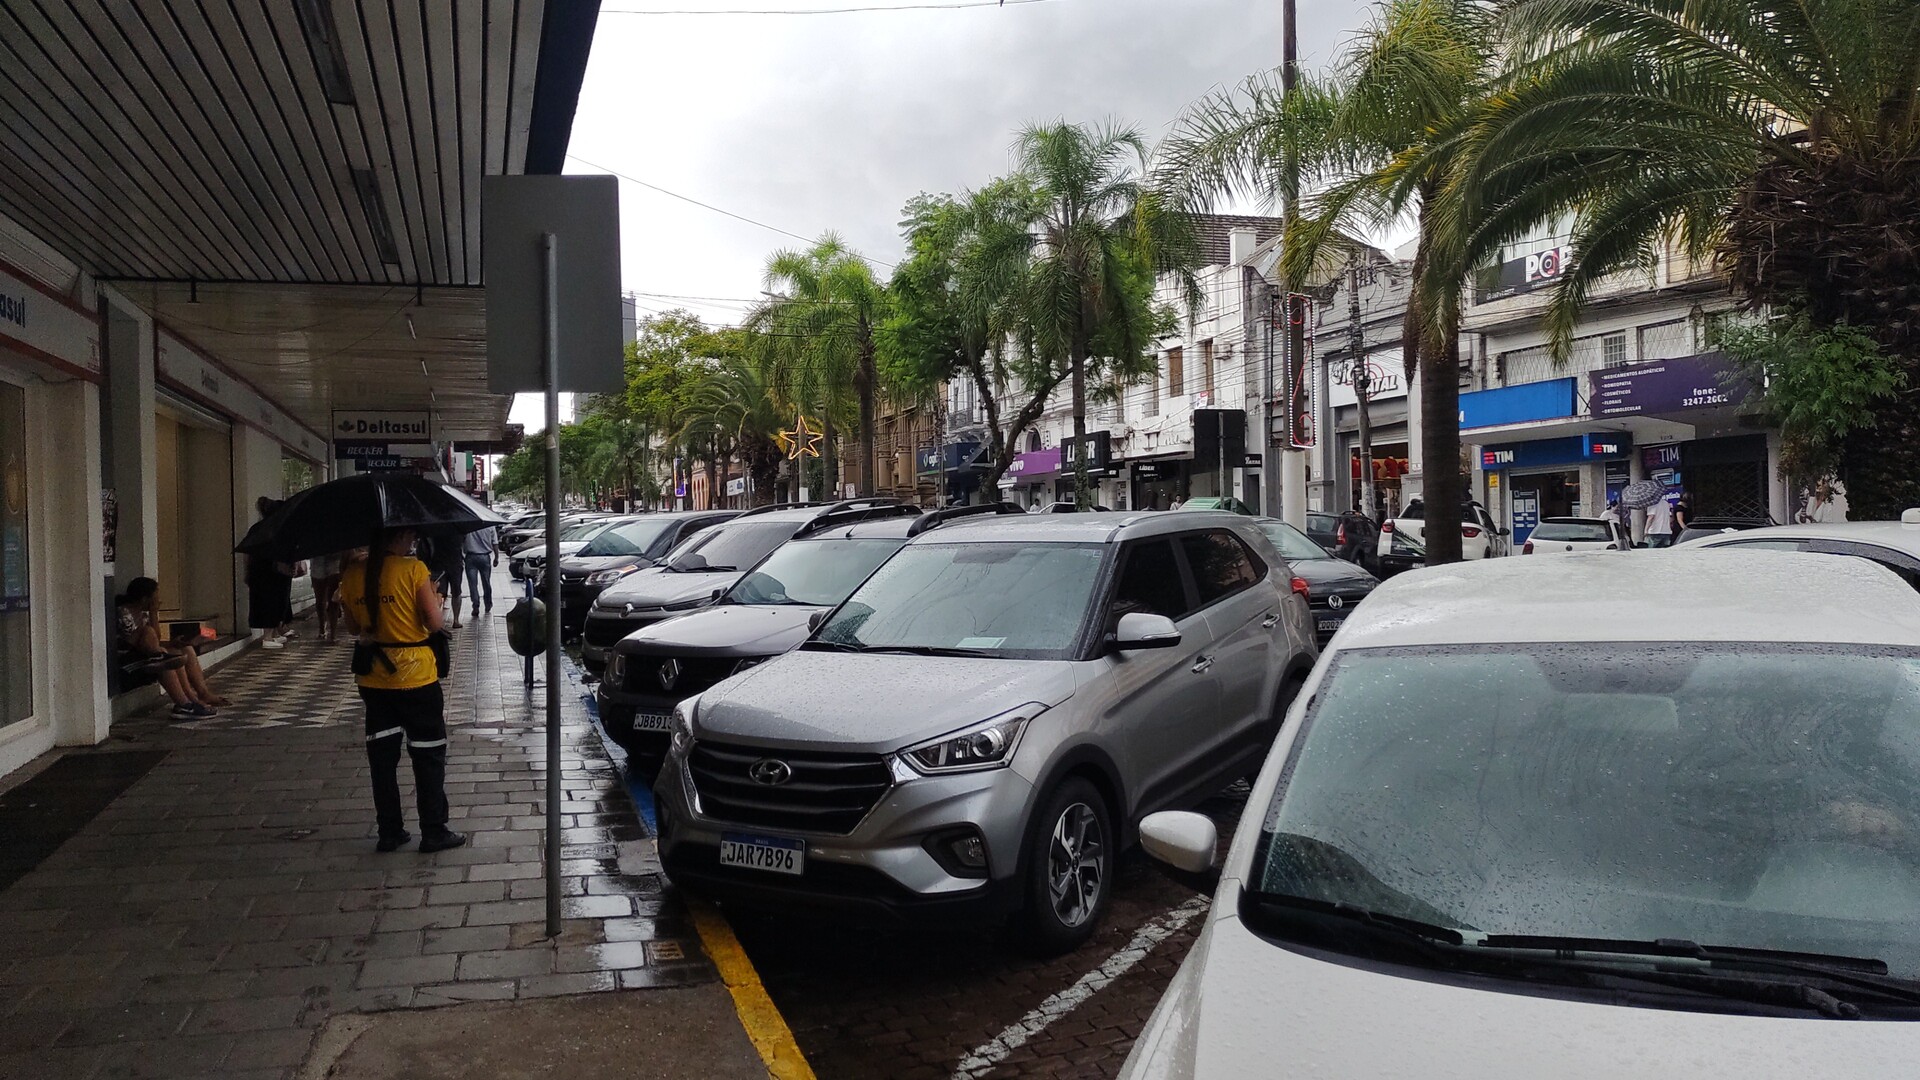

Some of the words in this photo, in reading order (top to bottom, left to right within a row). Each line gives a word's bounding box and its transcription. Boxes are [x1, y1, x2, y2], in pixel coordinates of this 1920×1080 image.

[1603, 371, 1638, 379] MEDICAMENTOS
[1365, 375, 1398, 393] ATAL
[1604, 389, 1631, 397] COSMÉTICOS
[1693, 387, 1716, 396] fone:
[356, 419, 426, 434] Deltasul
[347, 446, 383, 455] BECKER
[1602, 444, 1617, 454] TIM
[1659, 446, 1679, 463] TIM
[1494, 450, 1514, 464] TIM
[726, 843, 794, 870] JAR7B96
